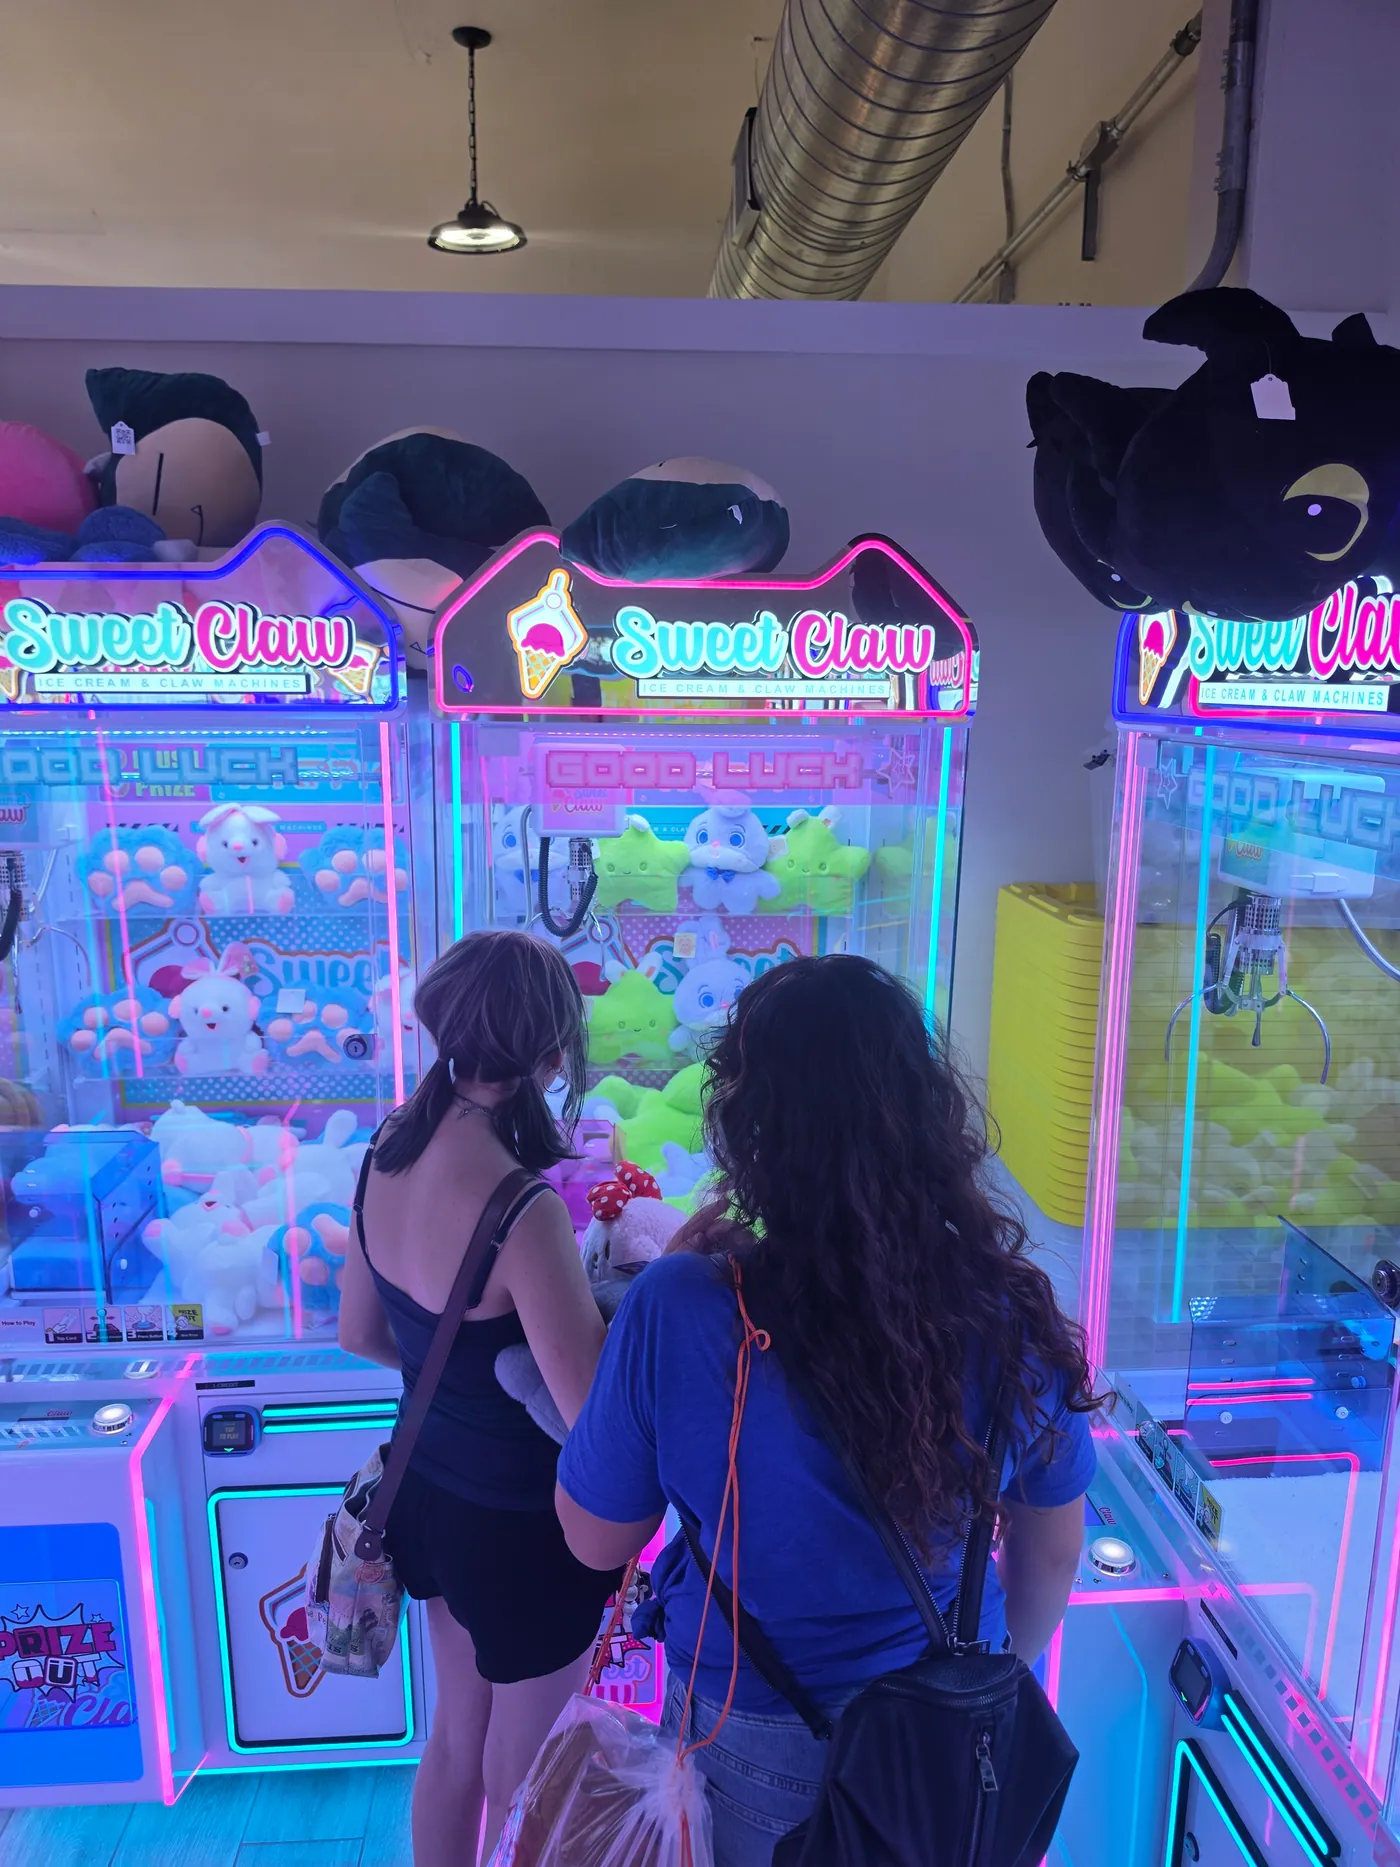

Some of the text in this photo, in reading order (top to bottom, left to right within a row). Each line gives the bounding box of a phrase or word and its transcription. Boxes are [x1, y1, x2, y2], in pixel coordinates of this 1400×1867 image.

[4, 598, 353, 672] Sweet Claw
[611, 606, 788, 678] Sweet
[790, 608, 935, 679] Claw
[38, 677, 302, 689] ICE CREAM & CLAW MACHINES
[642, 683, 886, 695] ICE CREAM & CLAW MACHINES
[1200, 687, 1384, 706] ICE CREAM & CLAW MACHINES
[0, 746, 120, 786] OOD
[137, 746, 300, 786] LUCK
[546, 750, 863, 790] GOOD LUCK
[1188, 766, 1280, 827] GOOD
[127, 1330, 137, 1339] 3
[12, 1652, 102, 1689] OUT
[602, 1656, 649, 1680] eet
[63, 1694, 132, 1727] Cla
